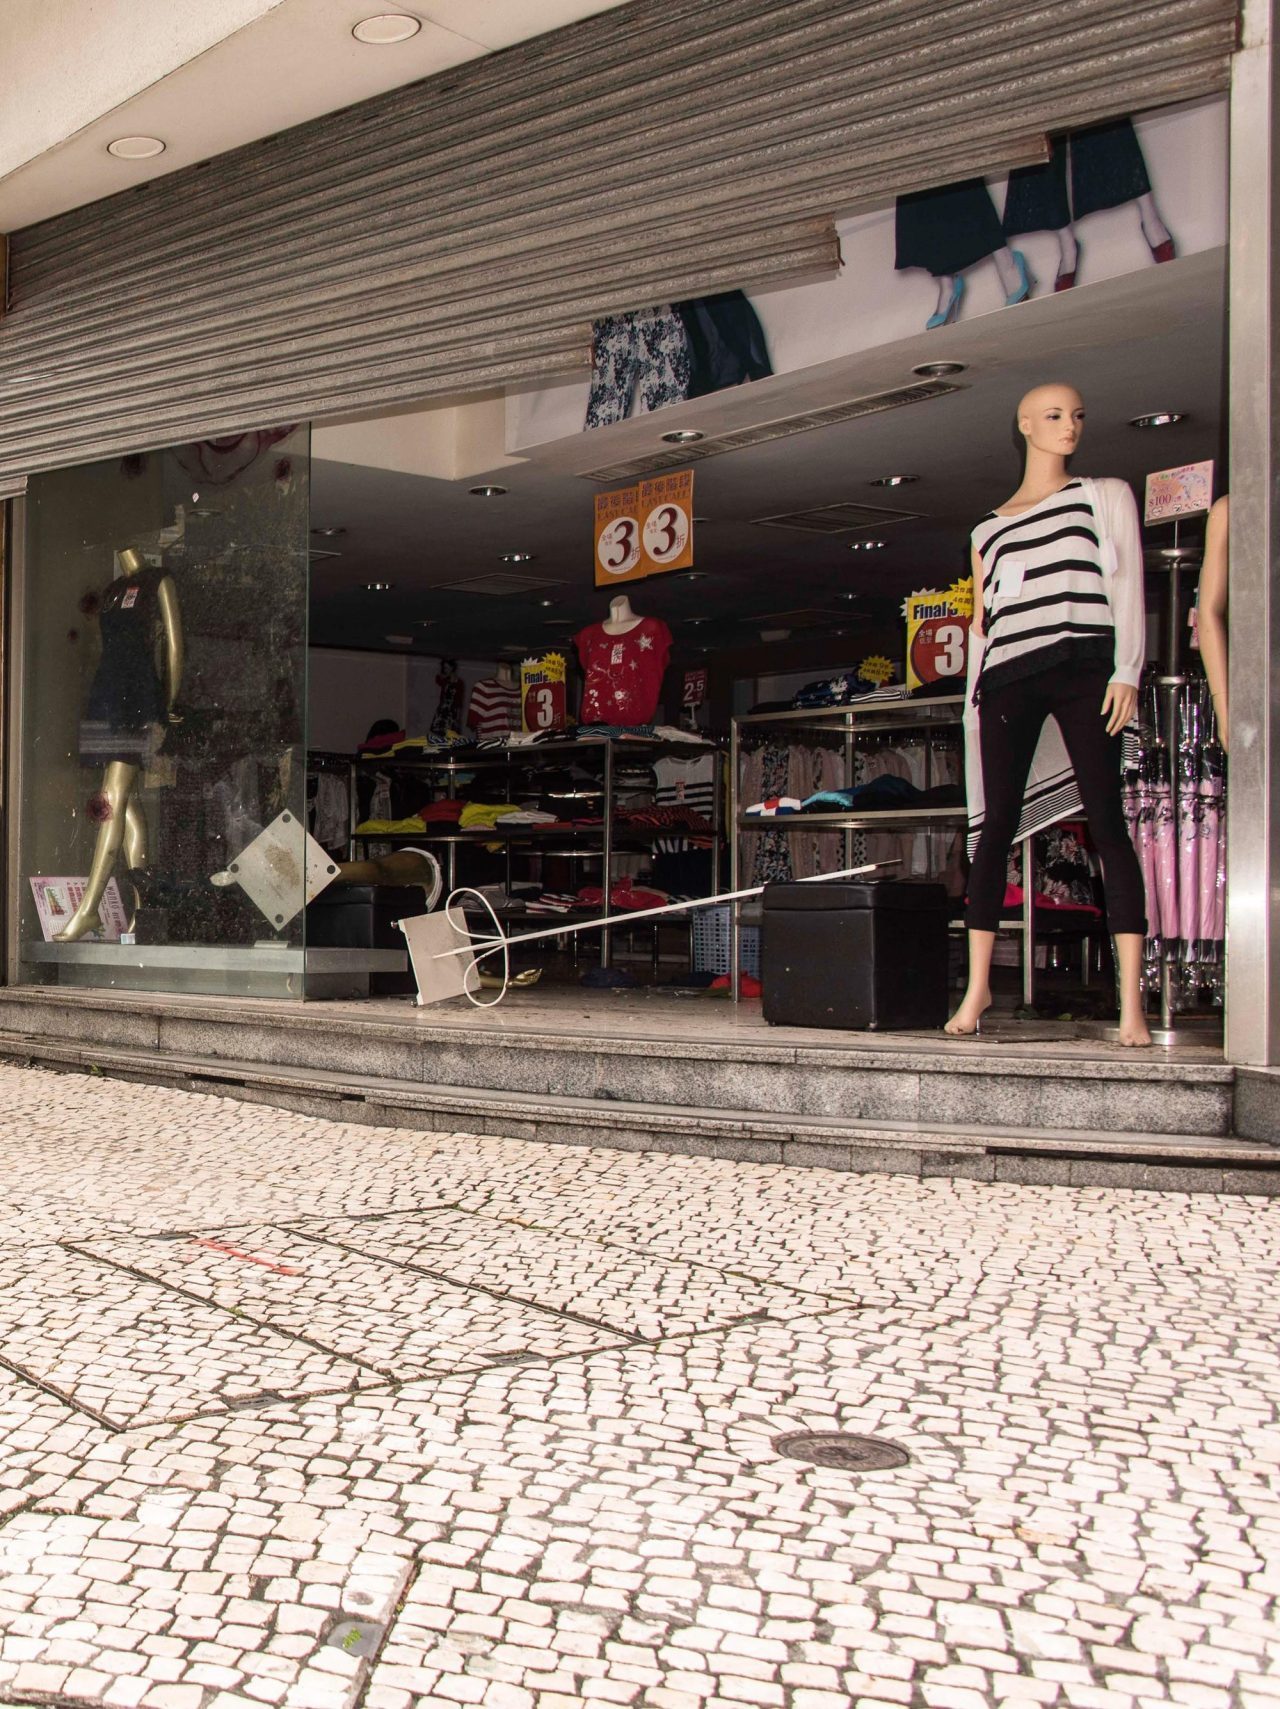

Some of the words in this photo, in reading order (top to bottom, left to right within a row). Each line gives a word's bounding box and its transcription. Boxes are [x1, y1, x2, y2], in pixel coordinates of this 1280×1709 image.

[608, 520, 634, 567] 3
[653, 507, 678, 556] 3
[913, 602, 947, 620] Final
[935, 625, 964, 676] 3
[525, 670, 543, 684] Final
[537, 689, 553, 728] 3
